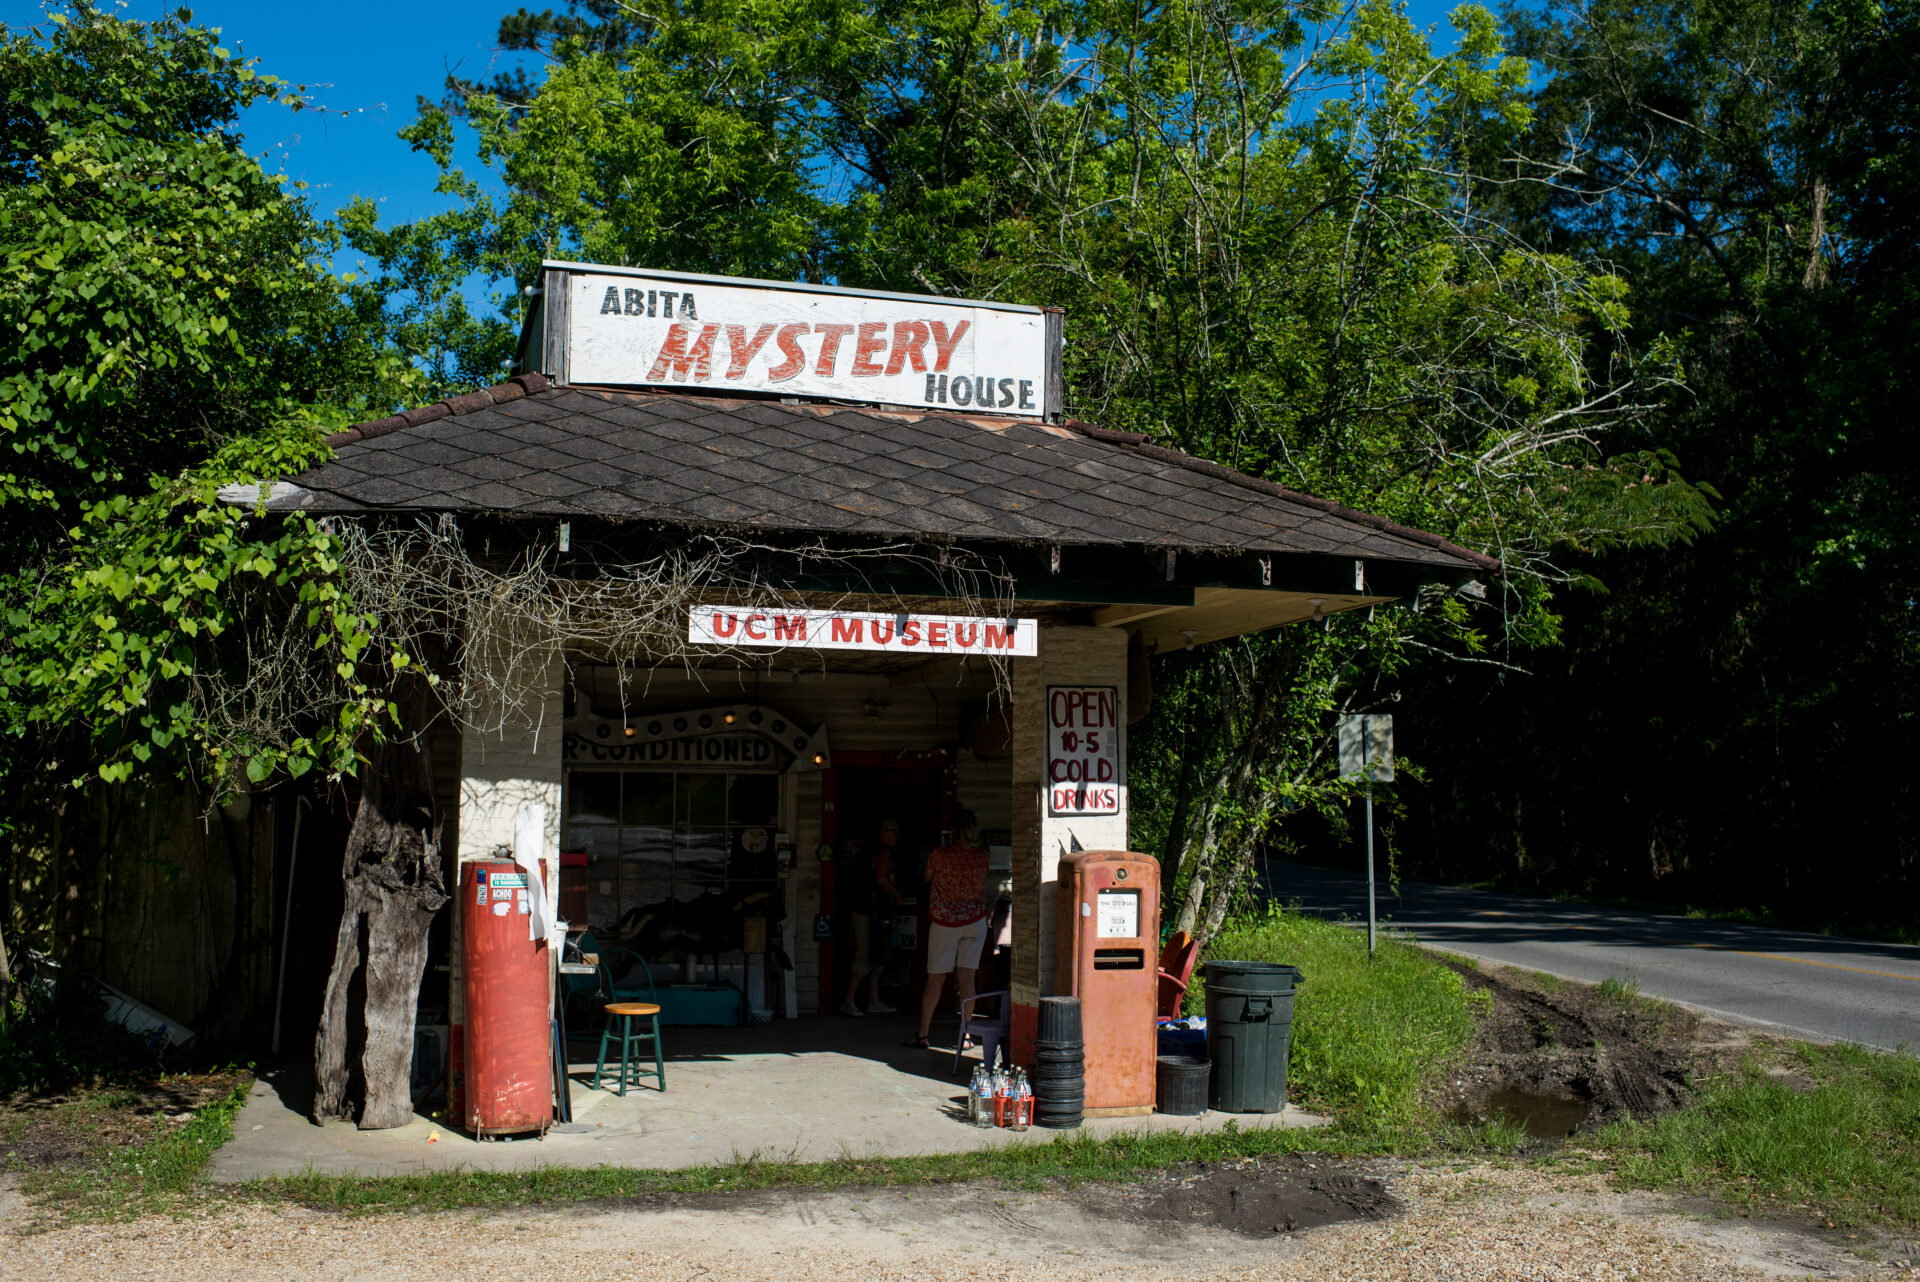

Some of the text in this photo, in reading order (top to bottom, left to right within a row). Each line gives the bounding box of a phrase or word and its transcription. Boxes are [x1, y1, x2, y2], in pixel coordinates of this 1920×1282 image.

[600, 286, 697, 321] ABITA
[645, 320, 971, 383] MYSTERY
[924, 372, 1036, 410] HOUSE
[712, 612, 1016, 650] UCM MUSEUM
[1051, 690, 1116, 729] OPEN
[1061, 731, 1100, 754] 10-5
[1051, 757, 1113, 783] COLD
[1053, 788, 1116, 811] DRINKS
